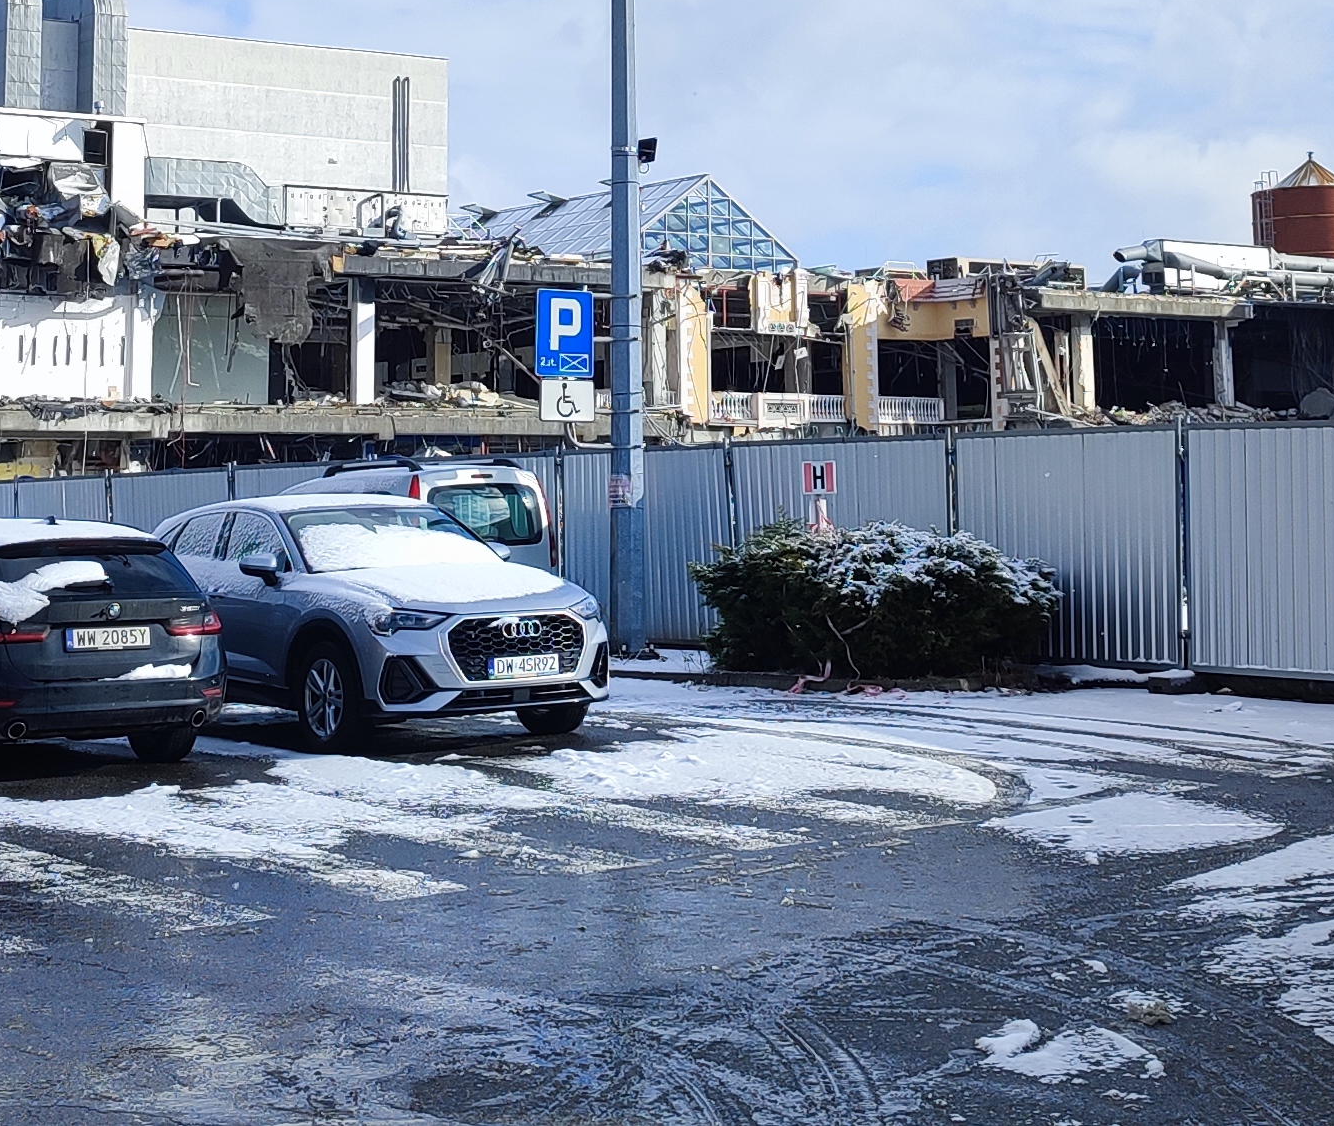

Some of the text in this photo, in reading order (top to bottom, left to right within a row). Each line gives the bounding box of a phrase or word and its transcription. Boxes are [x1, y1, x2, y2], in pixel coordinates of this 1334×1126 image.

[549, 297, 582, 351] P
[812, 465, 825, 490] H
[76, 631, 96, 646] WW
[102, 628, 147, 645] 2085Y
[497, 658, 514, 674] DW
